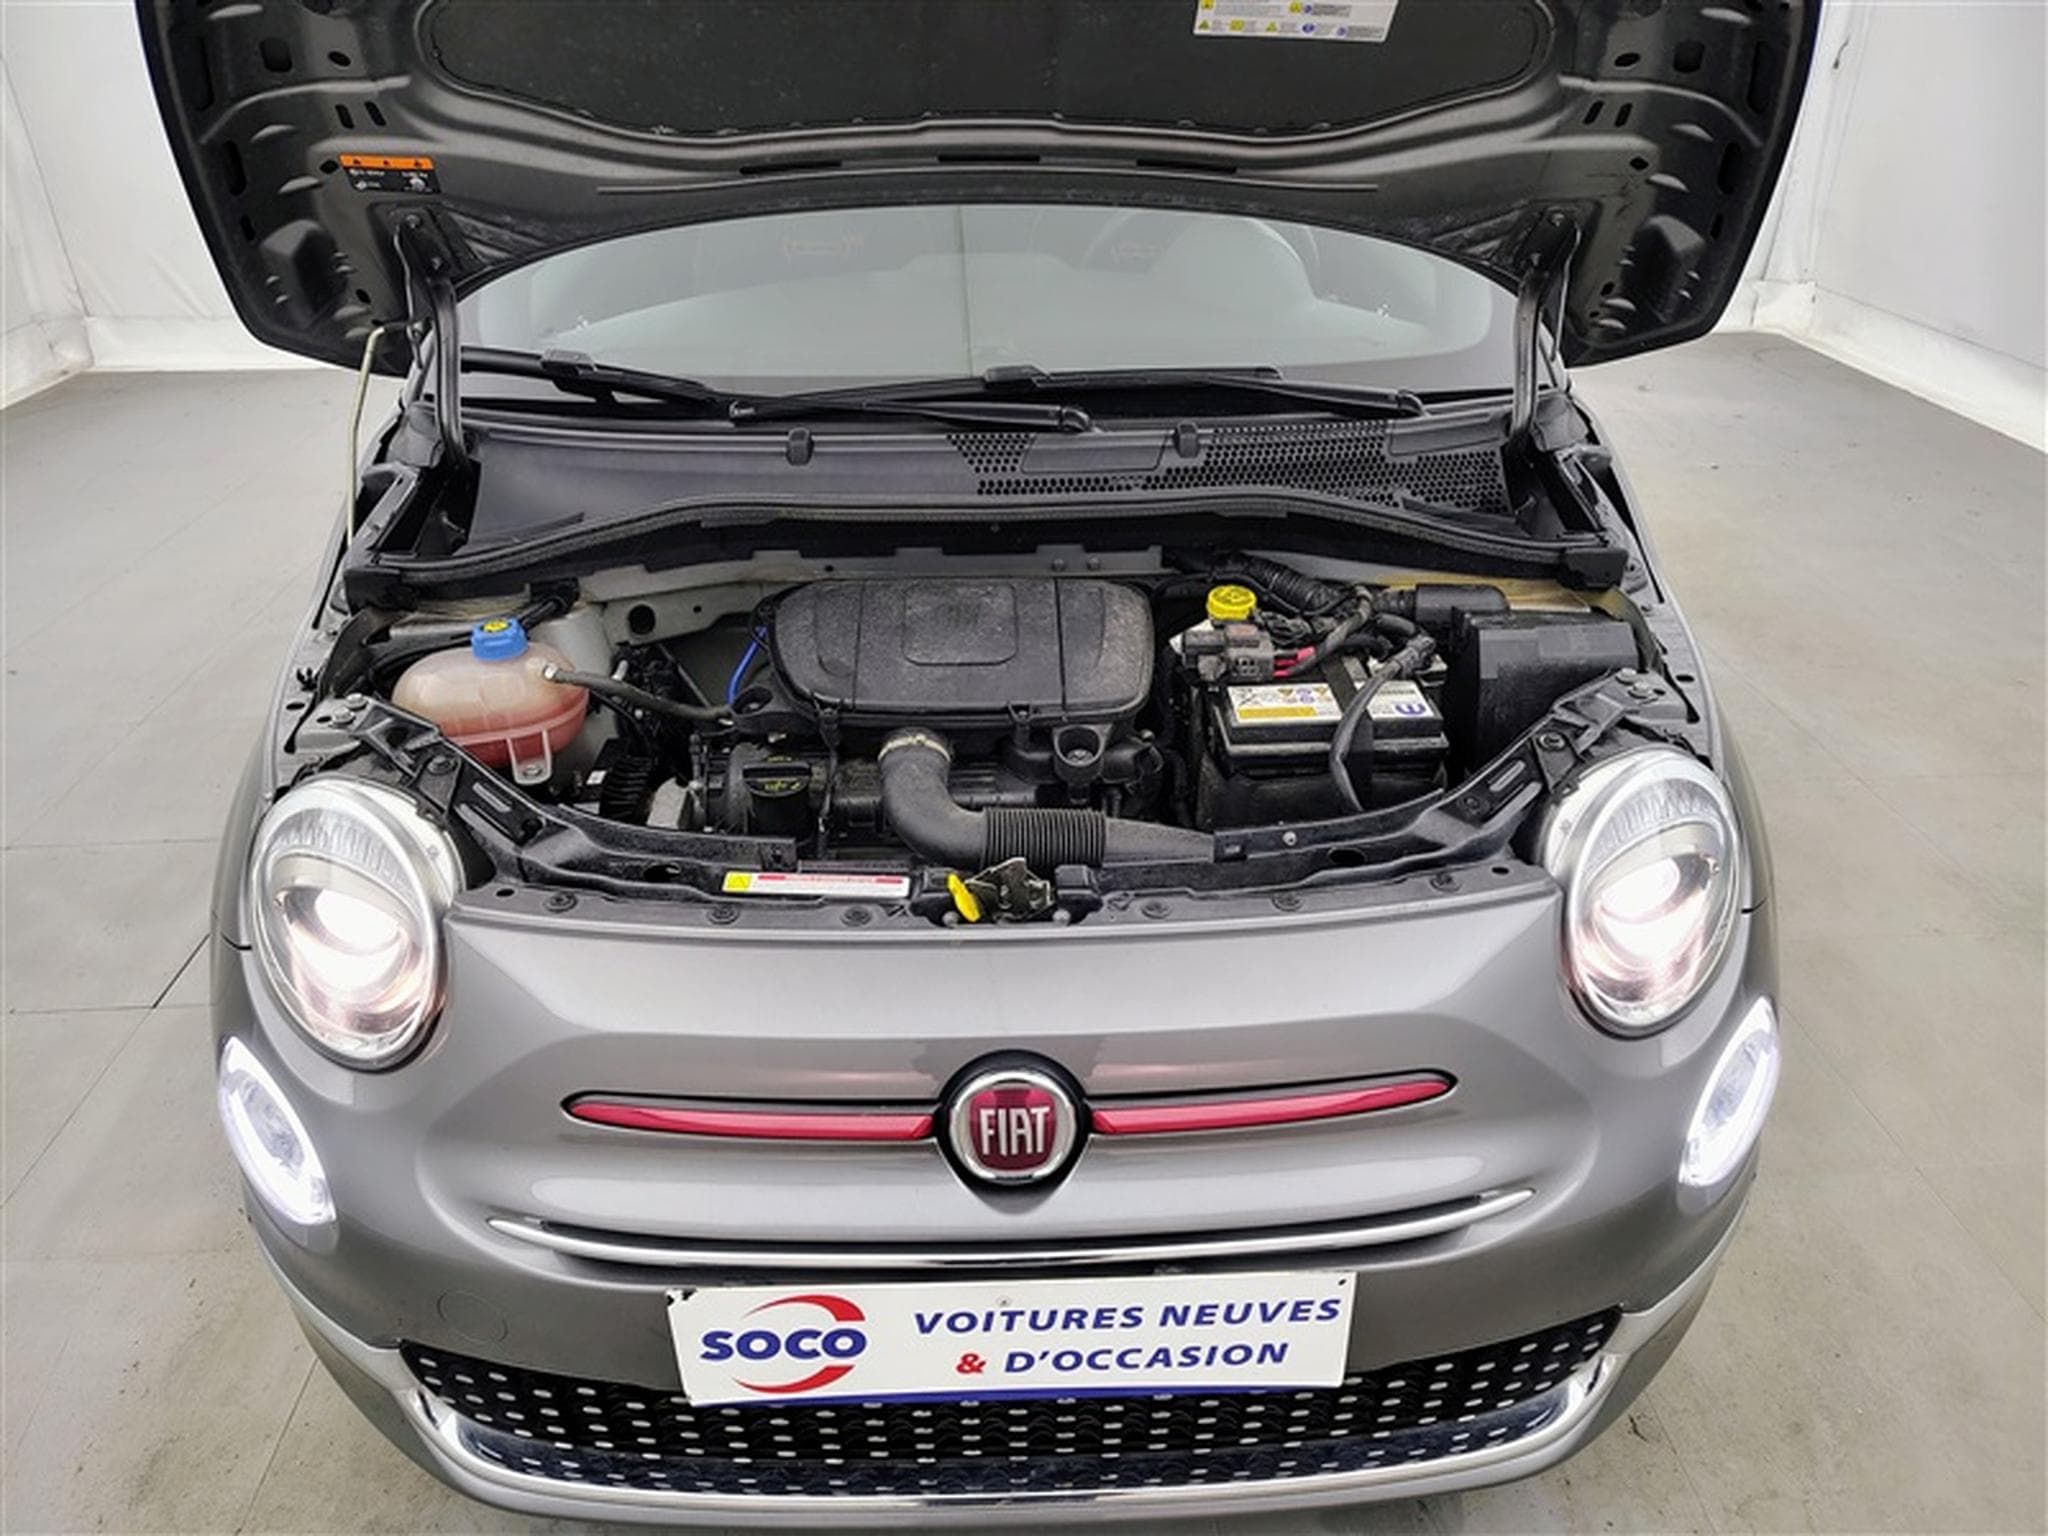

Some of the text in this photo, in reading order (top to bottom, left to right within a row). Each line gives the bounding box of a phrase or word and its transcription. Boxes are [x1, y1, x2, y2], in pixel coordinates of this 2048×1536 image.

[980, 1105, 1050, 1156] FIAT
[914, 1299, 1341, 1334] VOITURES NEUVES
[700, 1328, 866, 1361] SOCO
[956, 1342, 1288, 1374] & D'OCCASION
